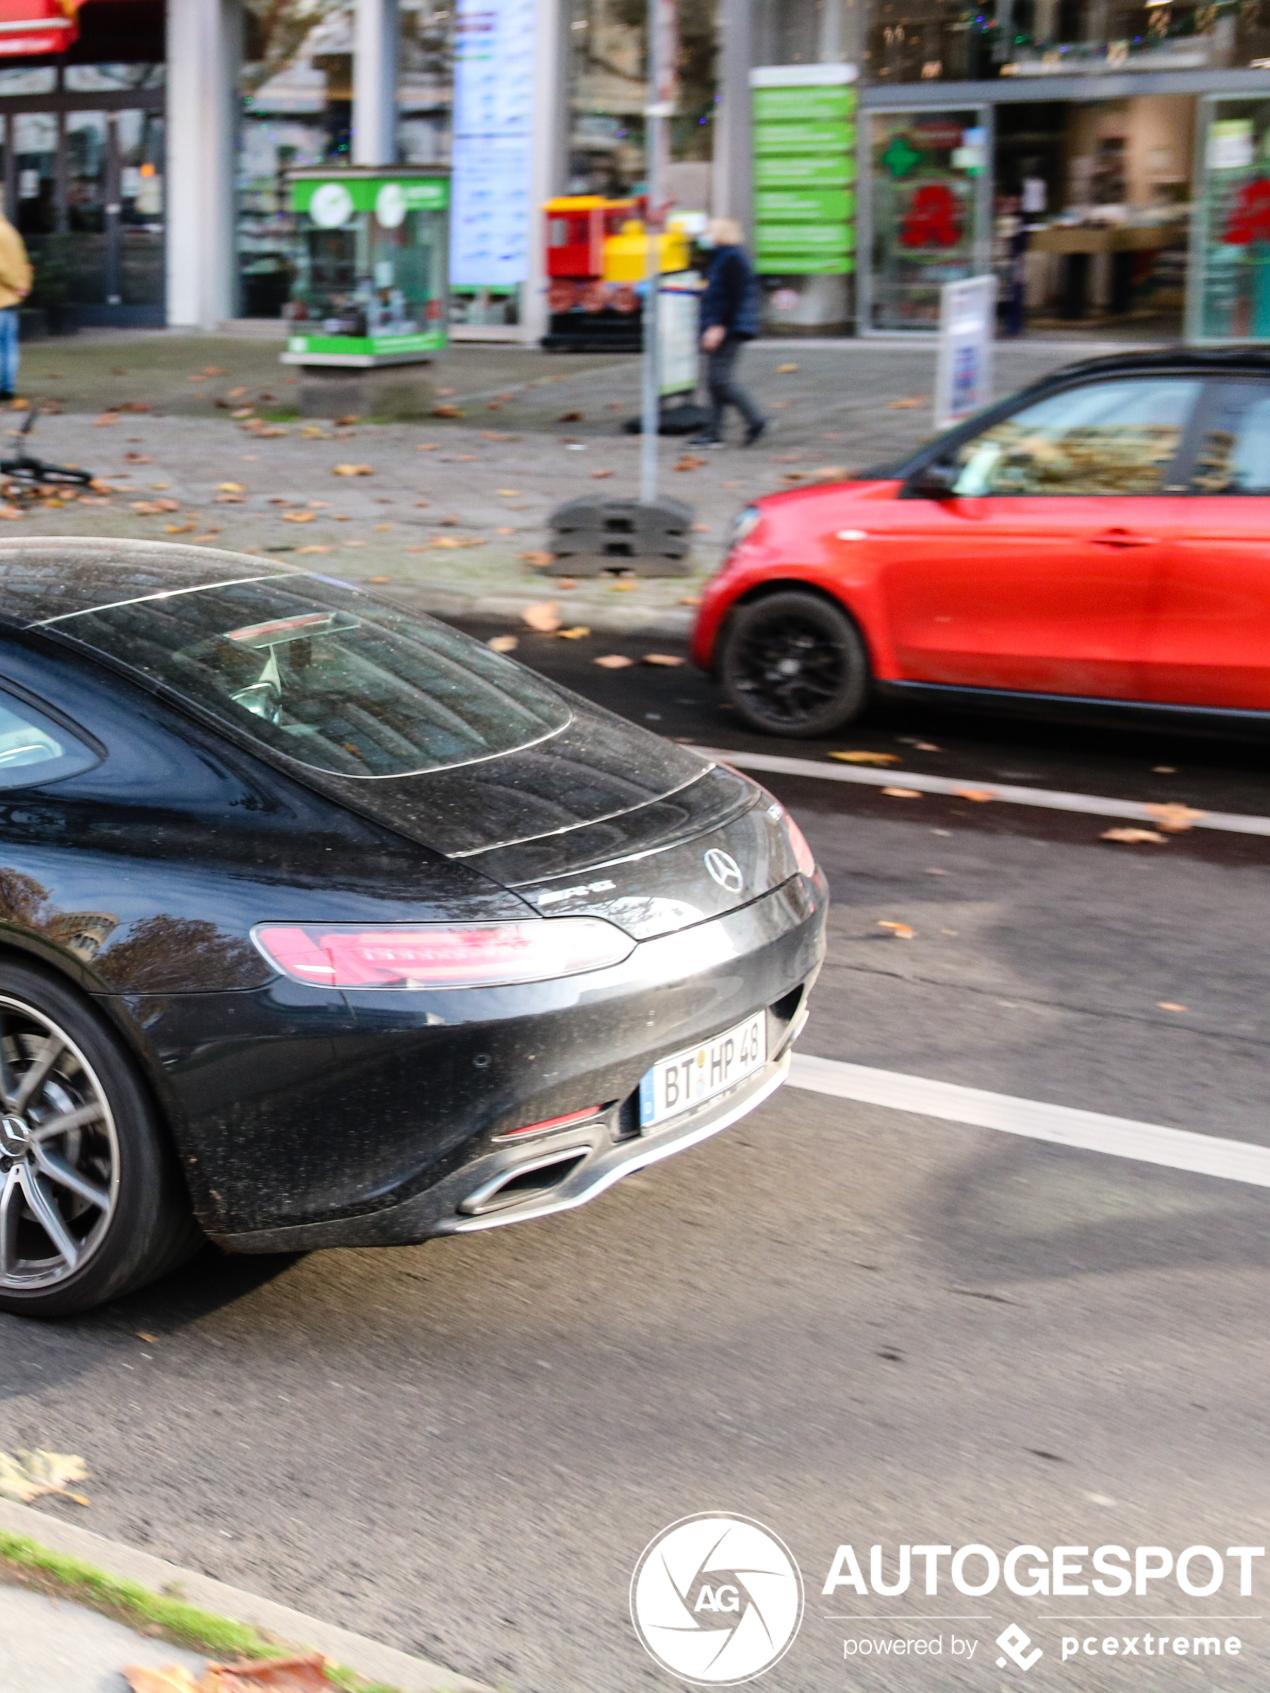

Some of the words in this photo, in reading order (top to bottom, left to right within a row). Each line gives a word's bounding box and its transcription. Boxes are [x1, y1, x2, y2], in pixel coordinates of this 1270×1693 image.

[664, 1057, 695, 1109] BT
[710, 1038, 735, 1088] HP
[739, 1022, 759, 1067] 48
